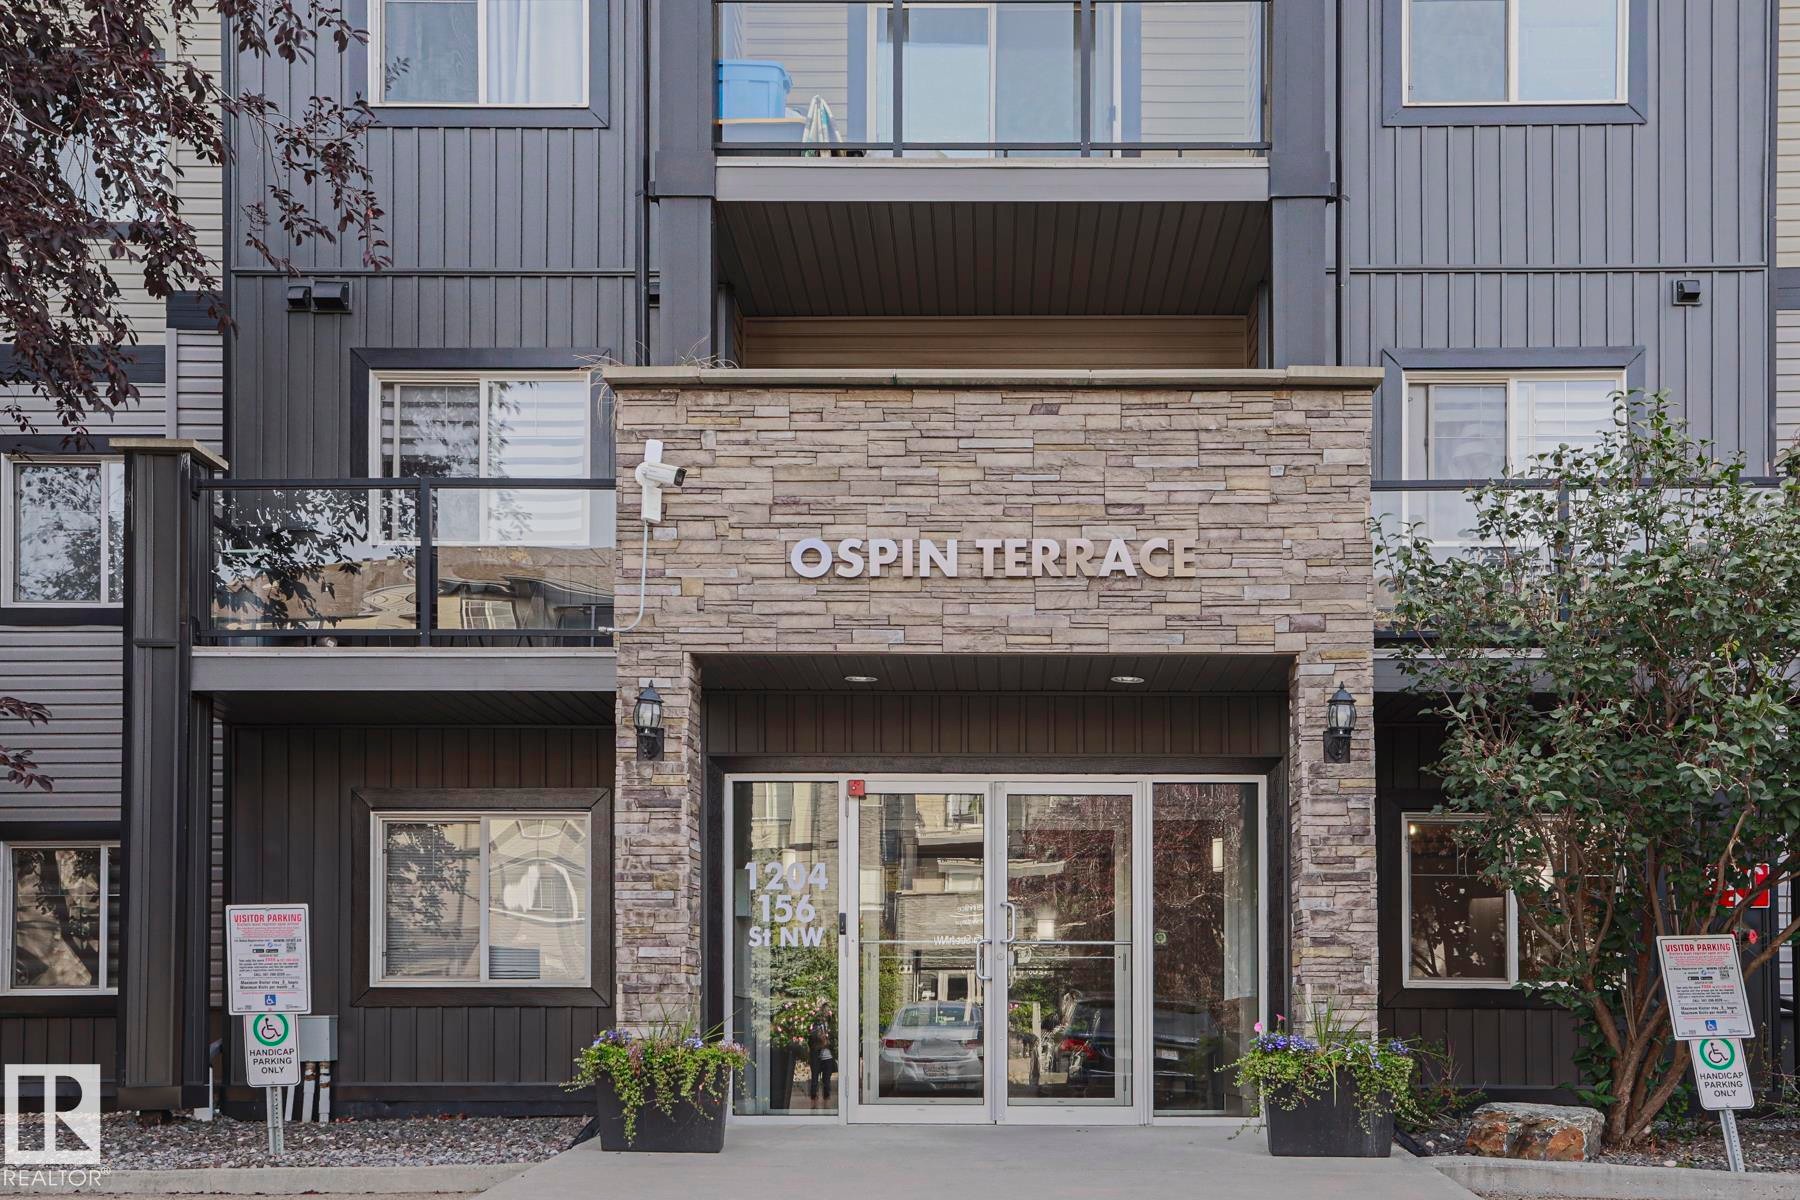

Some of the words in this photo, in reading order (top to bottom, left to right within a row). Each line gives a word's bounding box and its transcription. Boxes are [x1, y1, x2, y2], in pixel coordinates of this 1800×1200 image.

[789, 537, 958, 578] OSPIN
[975, 537, 1197, 578] TERRACE
[744, 861, 828, 891] 1204
[757, 894, 816, 923] 156
[234, 914, 265, 922] VISITOR
[267, 913, 302, 922] PARKING
[748, 925, 771, 947] St
[780, 926, 824, 947] NW
[1665, 944, 1695, 952] VISITOR
[1697, 943, 1731, 952] PARKING
[249, 1048, 295, 1056] HANDICAP
[253, 1057, 292, 1065] PARKING
[261, 1066, 284, 1074] ONLY
[1700, 1071, 1744, 1080] HANDICAP
[1704, 1080, 1743, 1088] PARKING
